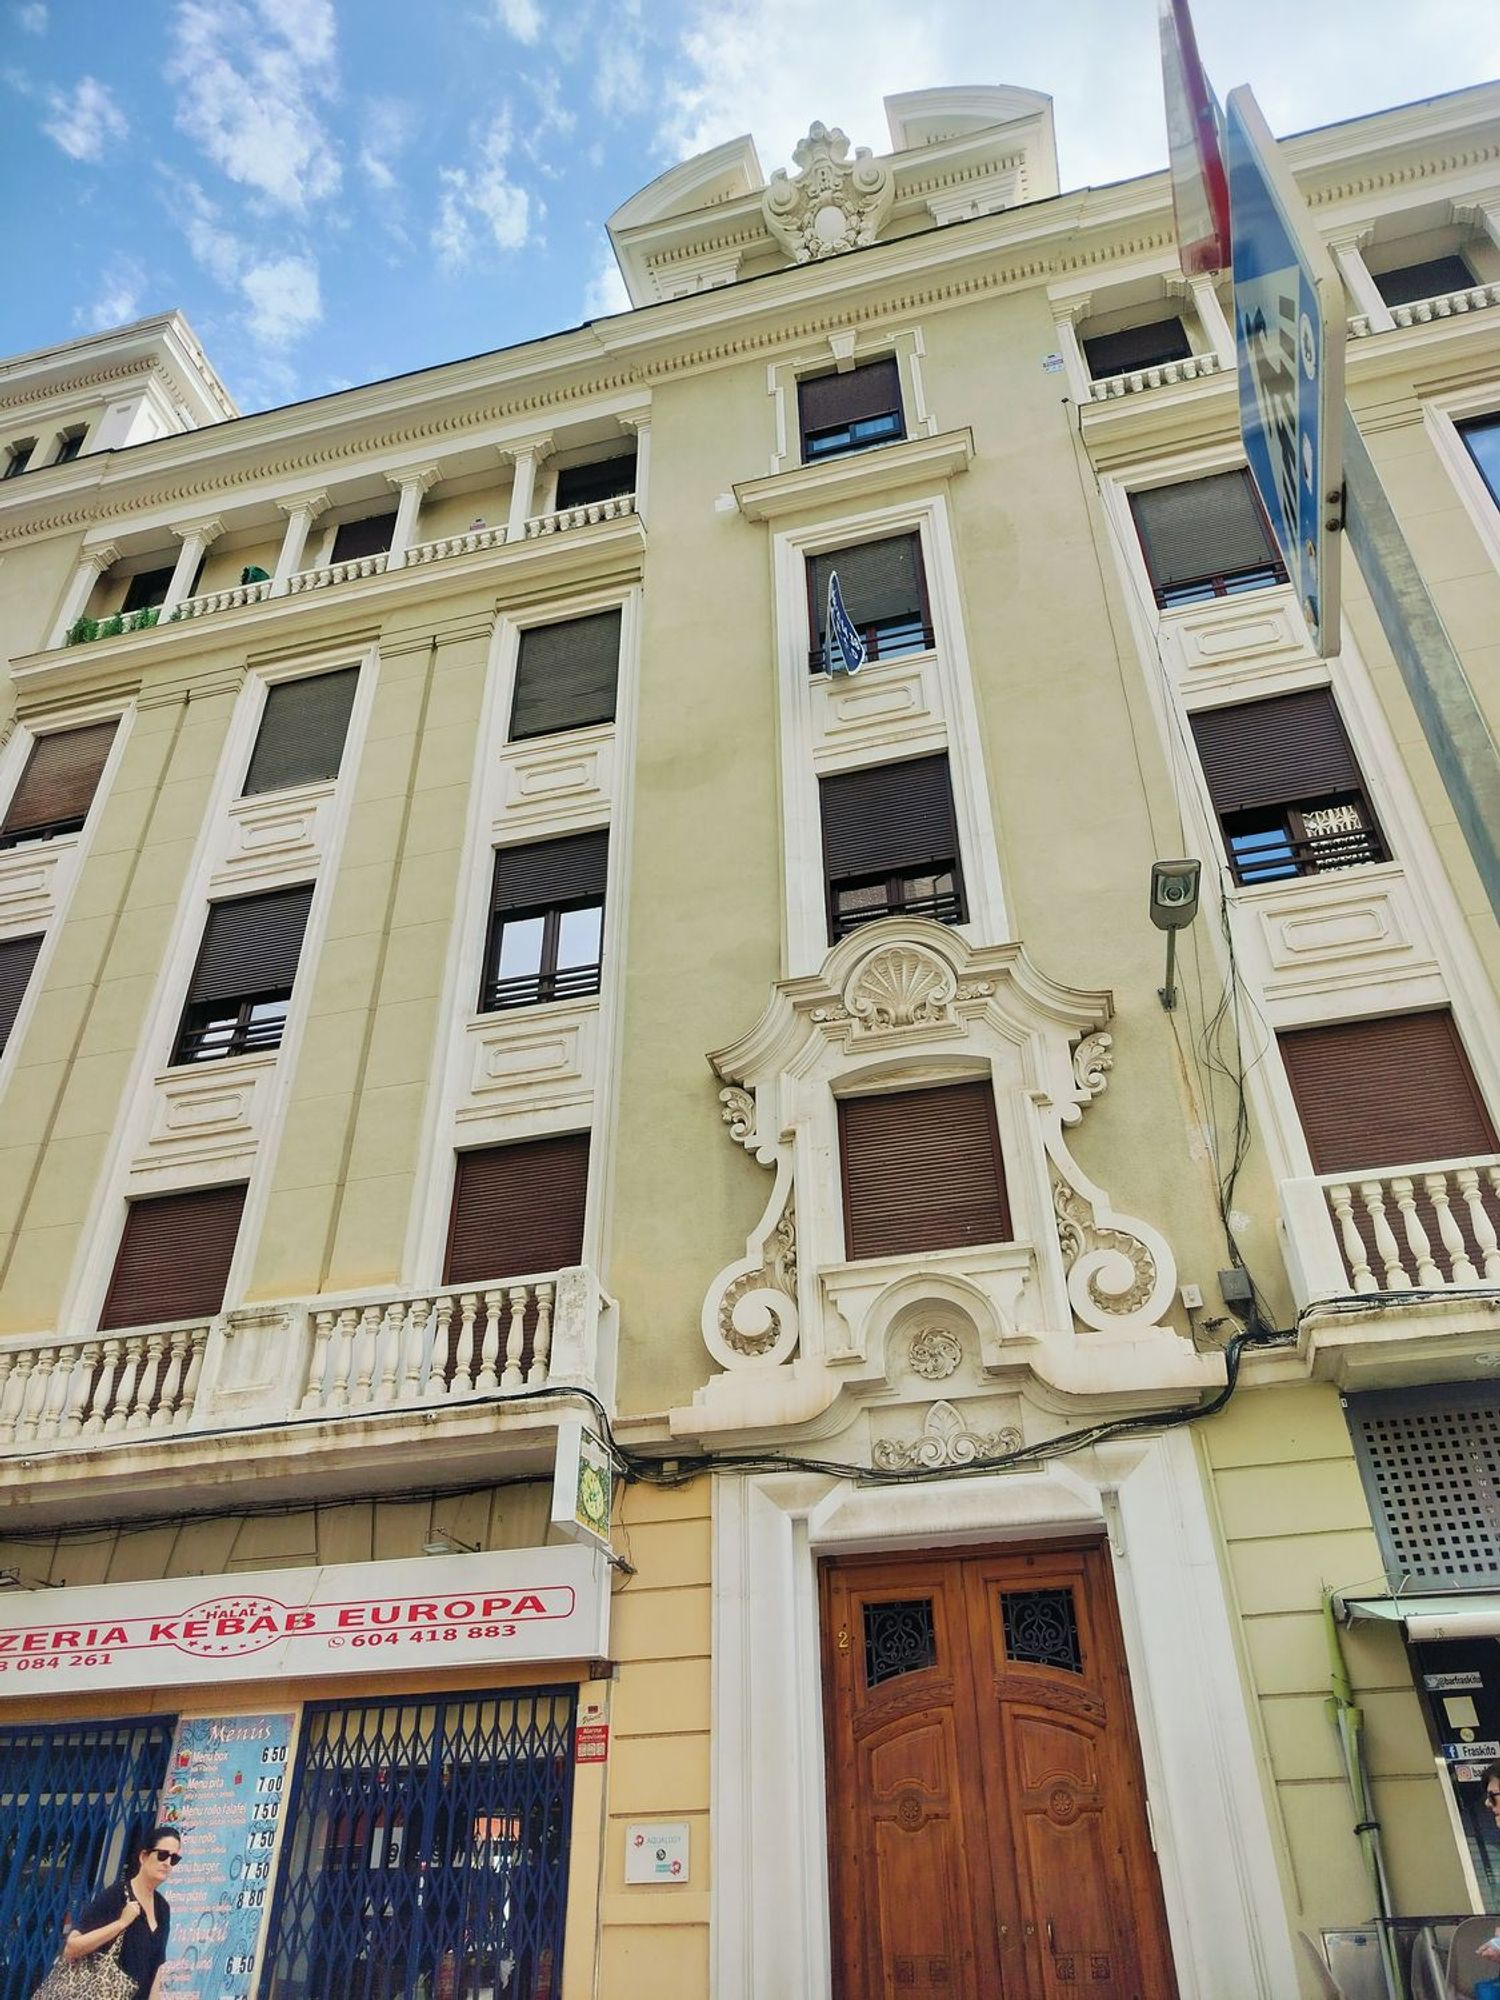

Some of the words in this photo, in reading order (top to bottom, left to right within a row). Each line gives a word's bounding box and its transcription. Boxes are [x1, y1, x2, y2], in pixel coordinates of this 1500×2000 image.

[150, 1615, 316, 1641] KEBAB
[338, 1595, 547, 1627] EUROPA
[205, 1608, 258, 1619] HALAL
[351, 1632, 399, 1647] 604
[409, 1629, 457, 1643] 418
[467, 1624, 516, 1639] 883
[838, 1630, 848, 1648] 2
[17, 1657, 59, 1671] 084
[68, 1653, 113, 1667] 261
[207, 1719, 272, 1745] Menús
[1462, 1744, 1497, 1757] Fraskito
